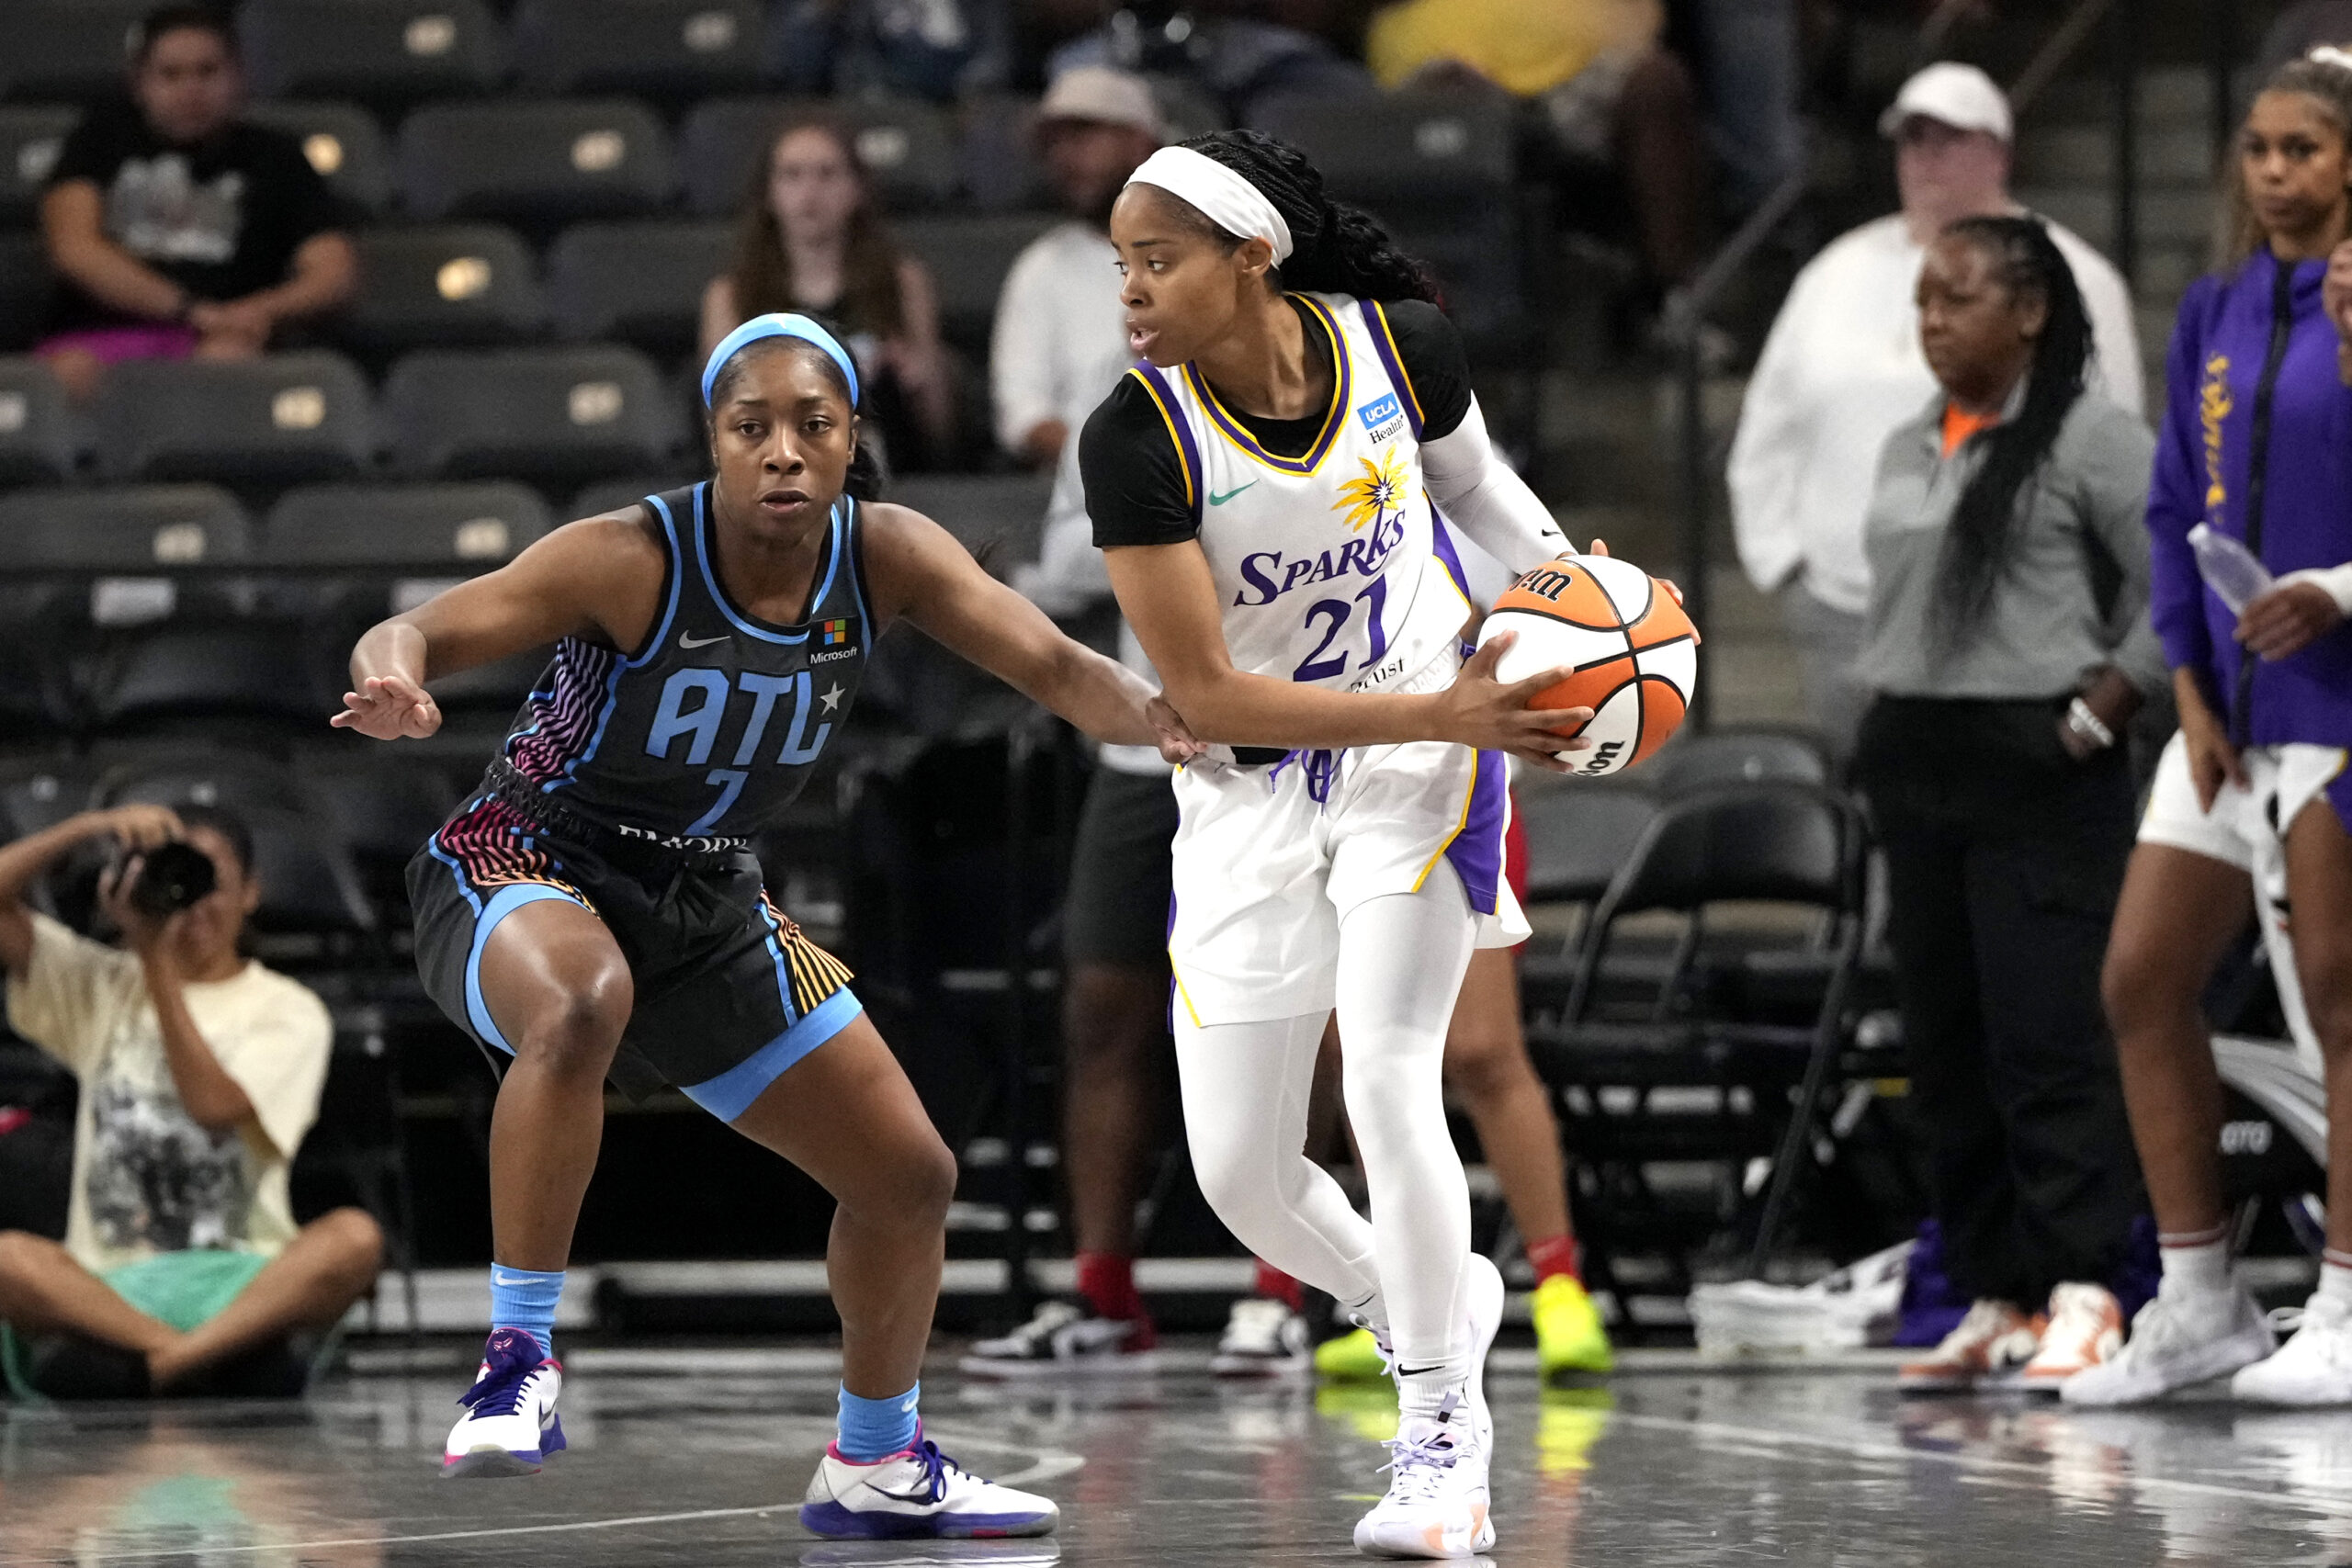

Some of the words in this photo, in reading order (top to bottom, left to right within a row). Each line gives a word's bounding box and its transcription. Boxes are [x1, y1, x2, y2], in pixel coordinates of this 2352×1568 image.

[1364, 400, 1396, 423] UCLA
[1369, 418, 1404, 445] Health
[1293, 572, 1386, 682] 21
[809, 646, 857, 664] Microsoft
[645, 668, 832, 766] ATL
[683, 768, 750, 837] 7
